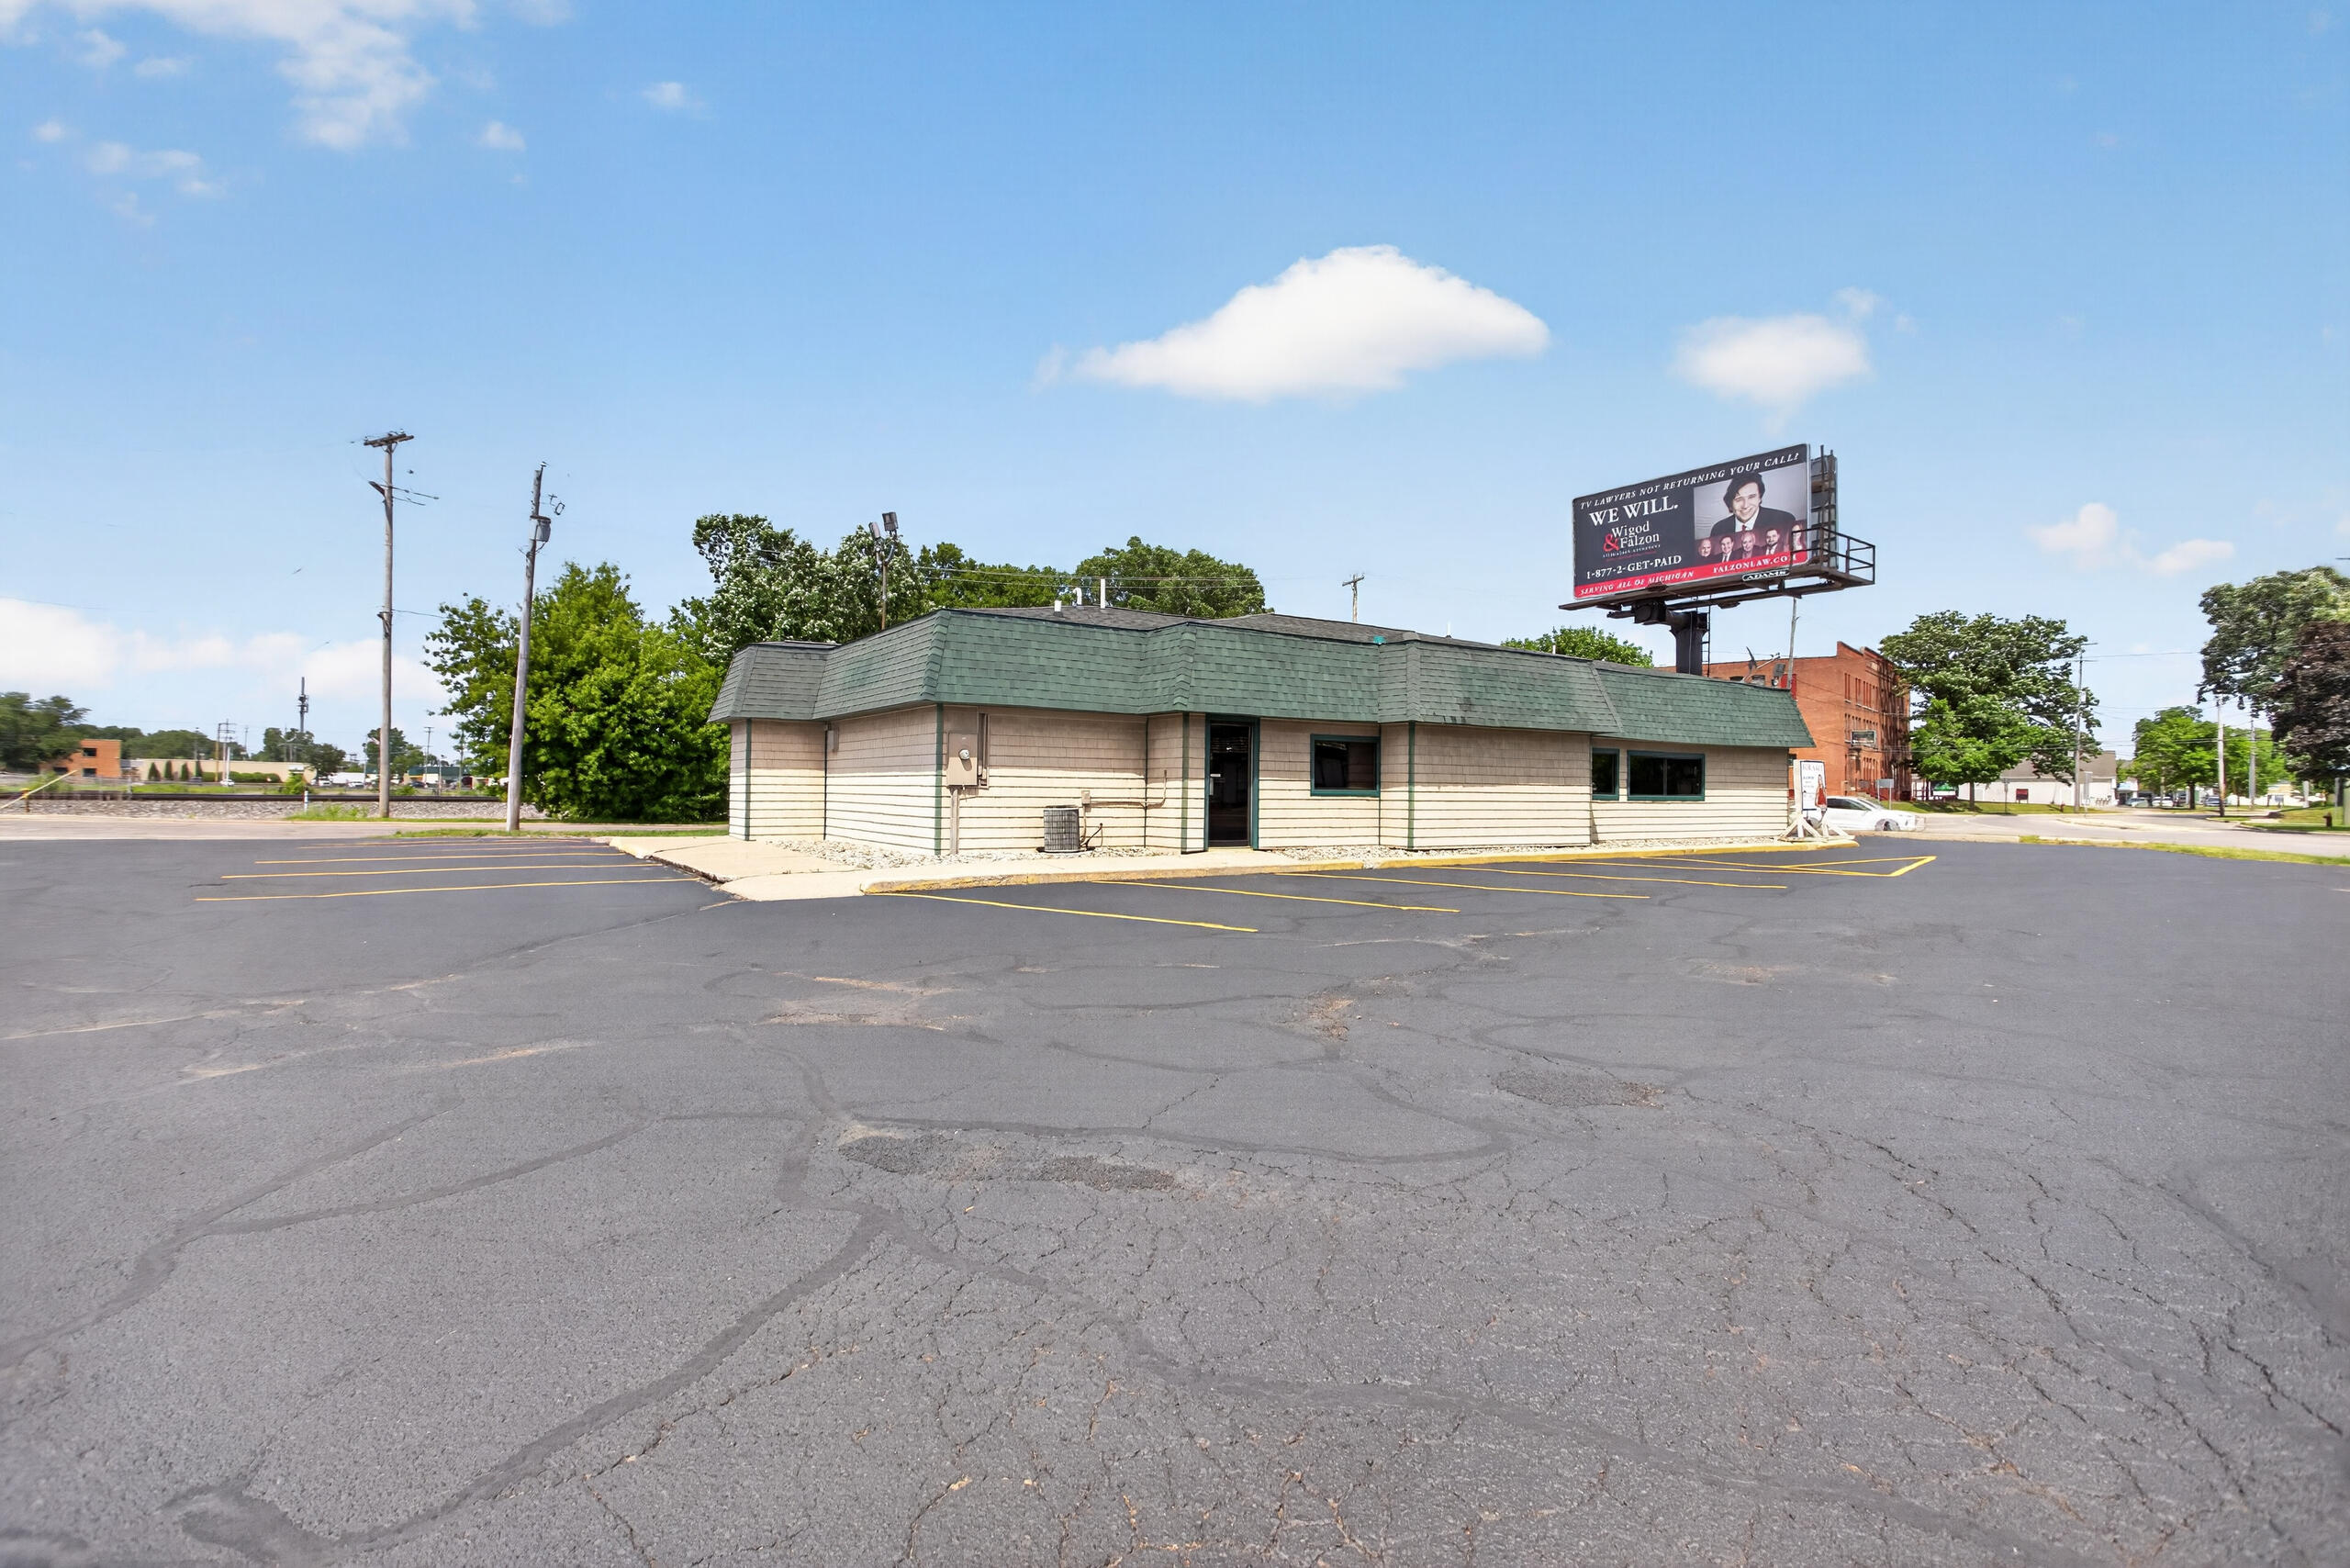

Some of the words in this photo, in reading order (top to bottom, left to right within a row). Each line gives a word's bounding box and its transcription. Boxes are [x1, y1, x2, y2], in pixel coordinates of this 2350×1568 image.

[1581, 500, 1592, 510] TV
[1595, 490, 1636, 506] LAWYERS
[1639, 485, 1662, 496] NOT
[1663, 469, 1726, 490] RETURNING
[1730, 462, 1761, 476] YOUR
[1764, 453, 1799, 467] CALL?
[1589, 508, 1619, 526] WE
[1623, 496, 1679, 519] WILL.
[1603, 532, 1620, 552] &
[1620, 533, 1660, 549] Falzon
[1612, 521, 1650, 538] Wigod
[1586, 554, 1682, 579] 1-877-2-GET-PAID
[1748, 570, 1786, 579] ADAMS
[1581, 584, 1614, 596] SERVING
[1617, 581, 1632, 590] ALL
[1635, 578, 1645, 587] OF
[1648, 571, 1695, 585] MICHIGAN
